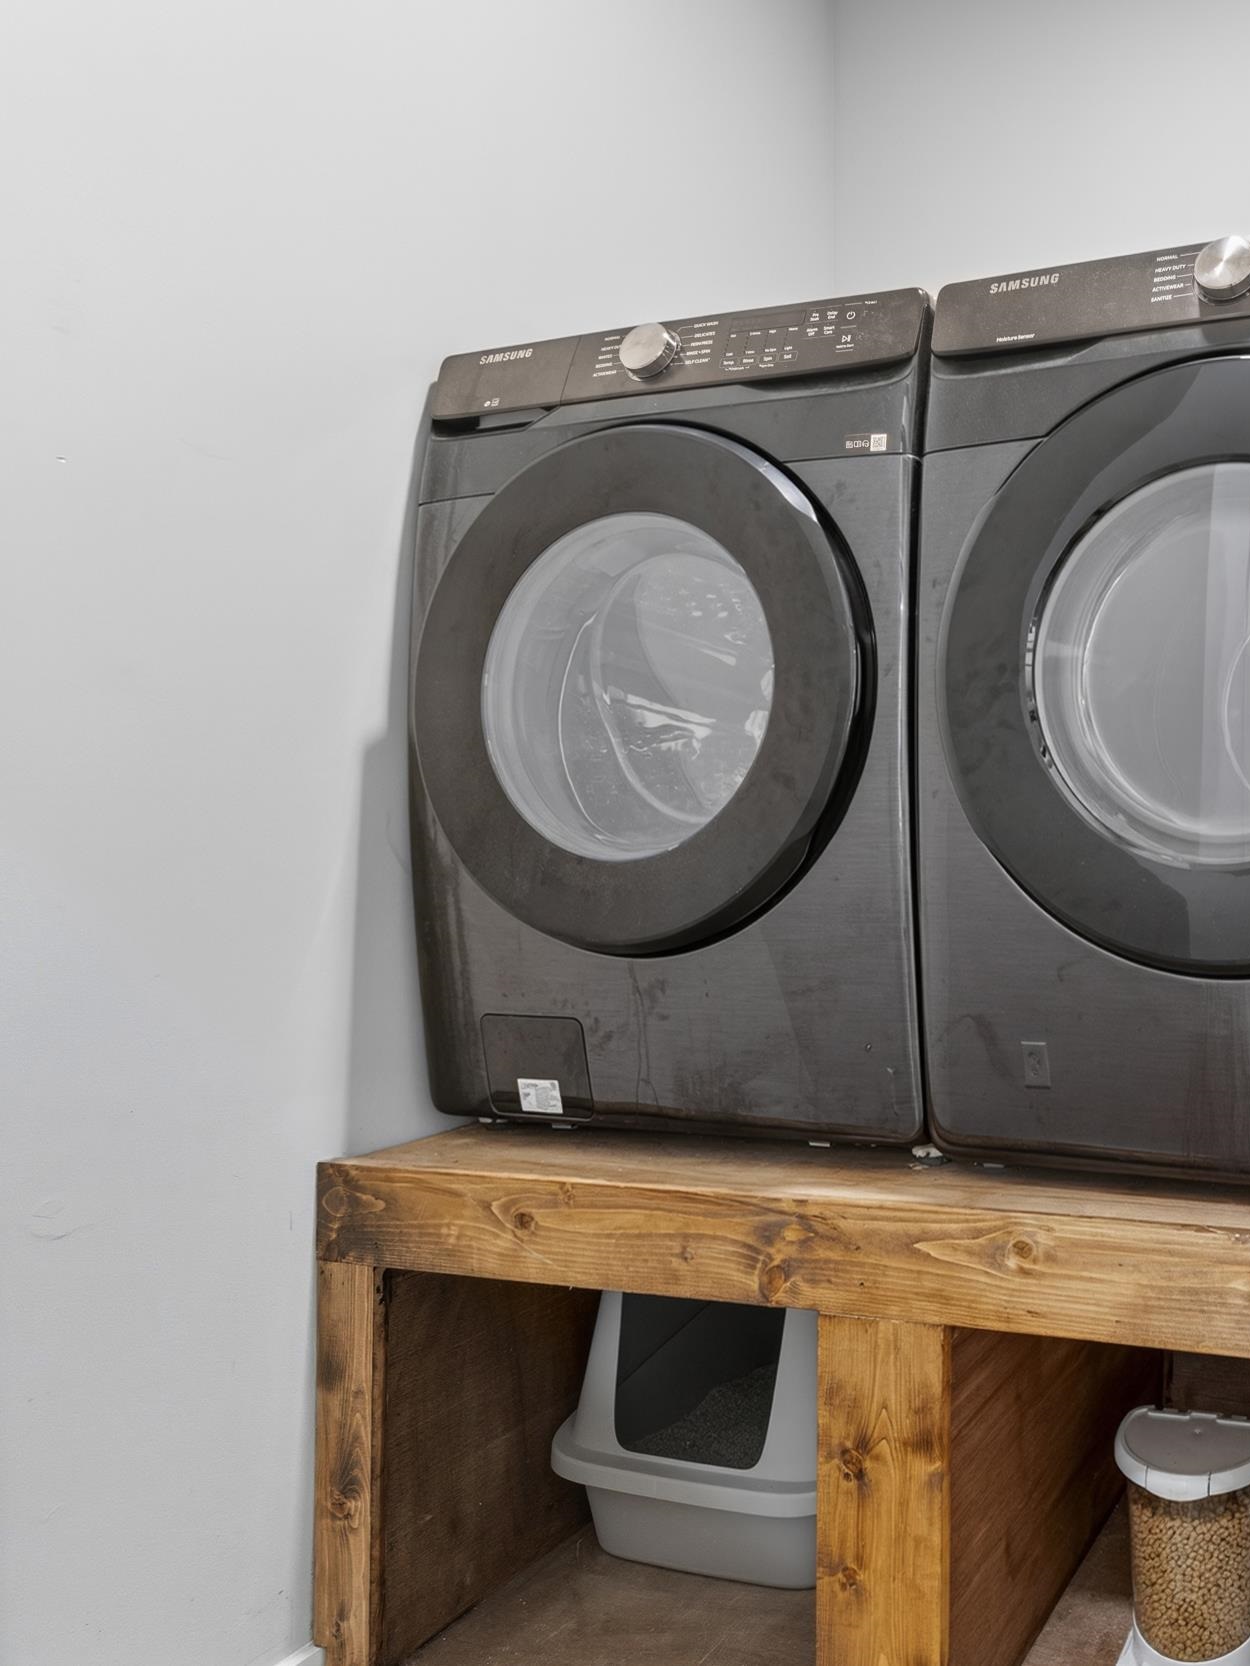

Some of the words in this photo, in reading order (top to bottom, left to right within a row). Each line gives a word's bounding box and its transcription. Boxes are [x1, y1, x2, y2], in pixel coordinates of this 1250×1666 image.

[1156, 254, 1178, 262] NORMAL
[989, 272, 1060, 294] SAMSUNG
[1153, 274, 1176, 283] BEDDING
[1152, 282, 1184, 293] ACTIVEWEAR
[1150, 294, 1173, 303] SANITIZE
[996, 335, 1018, 343] Moisture
[479, 348, 533, 365] SAMSUNG
[592, 370, 617, 378] ACTIVEWEAR
